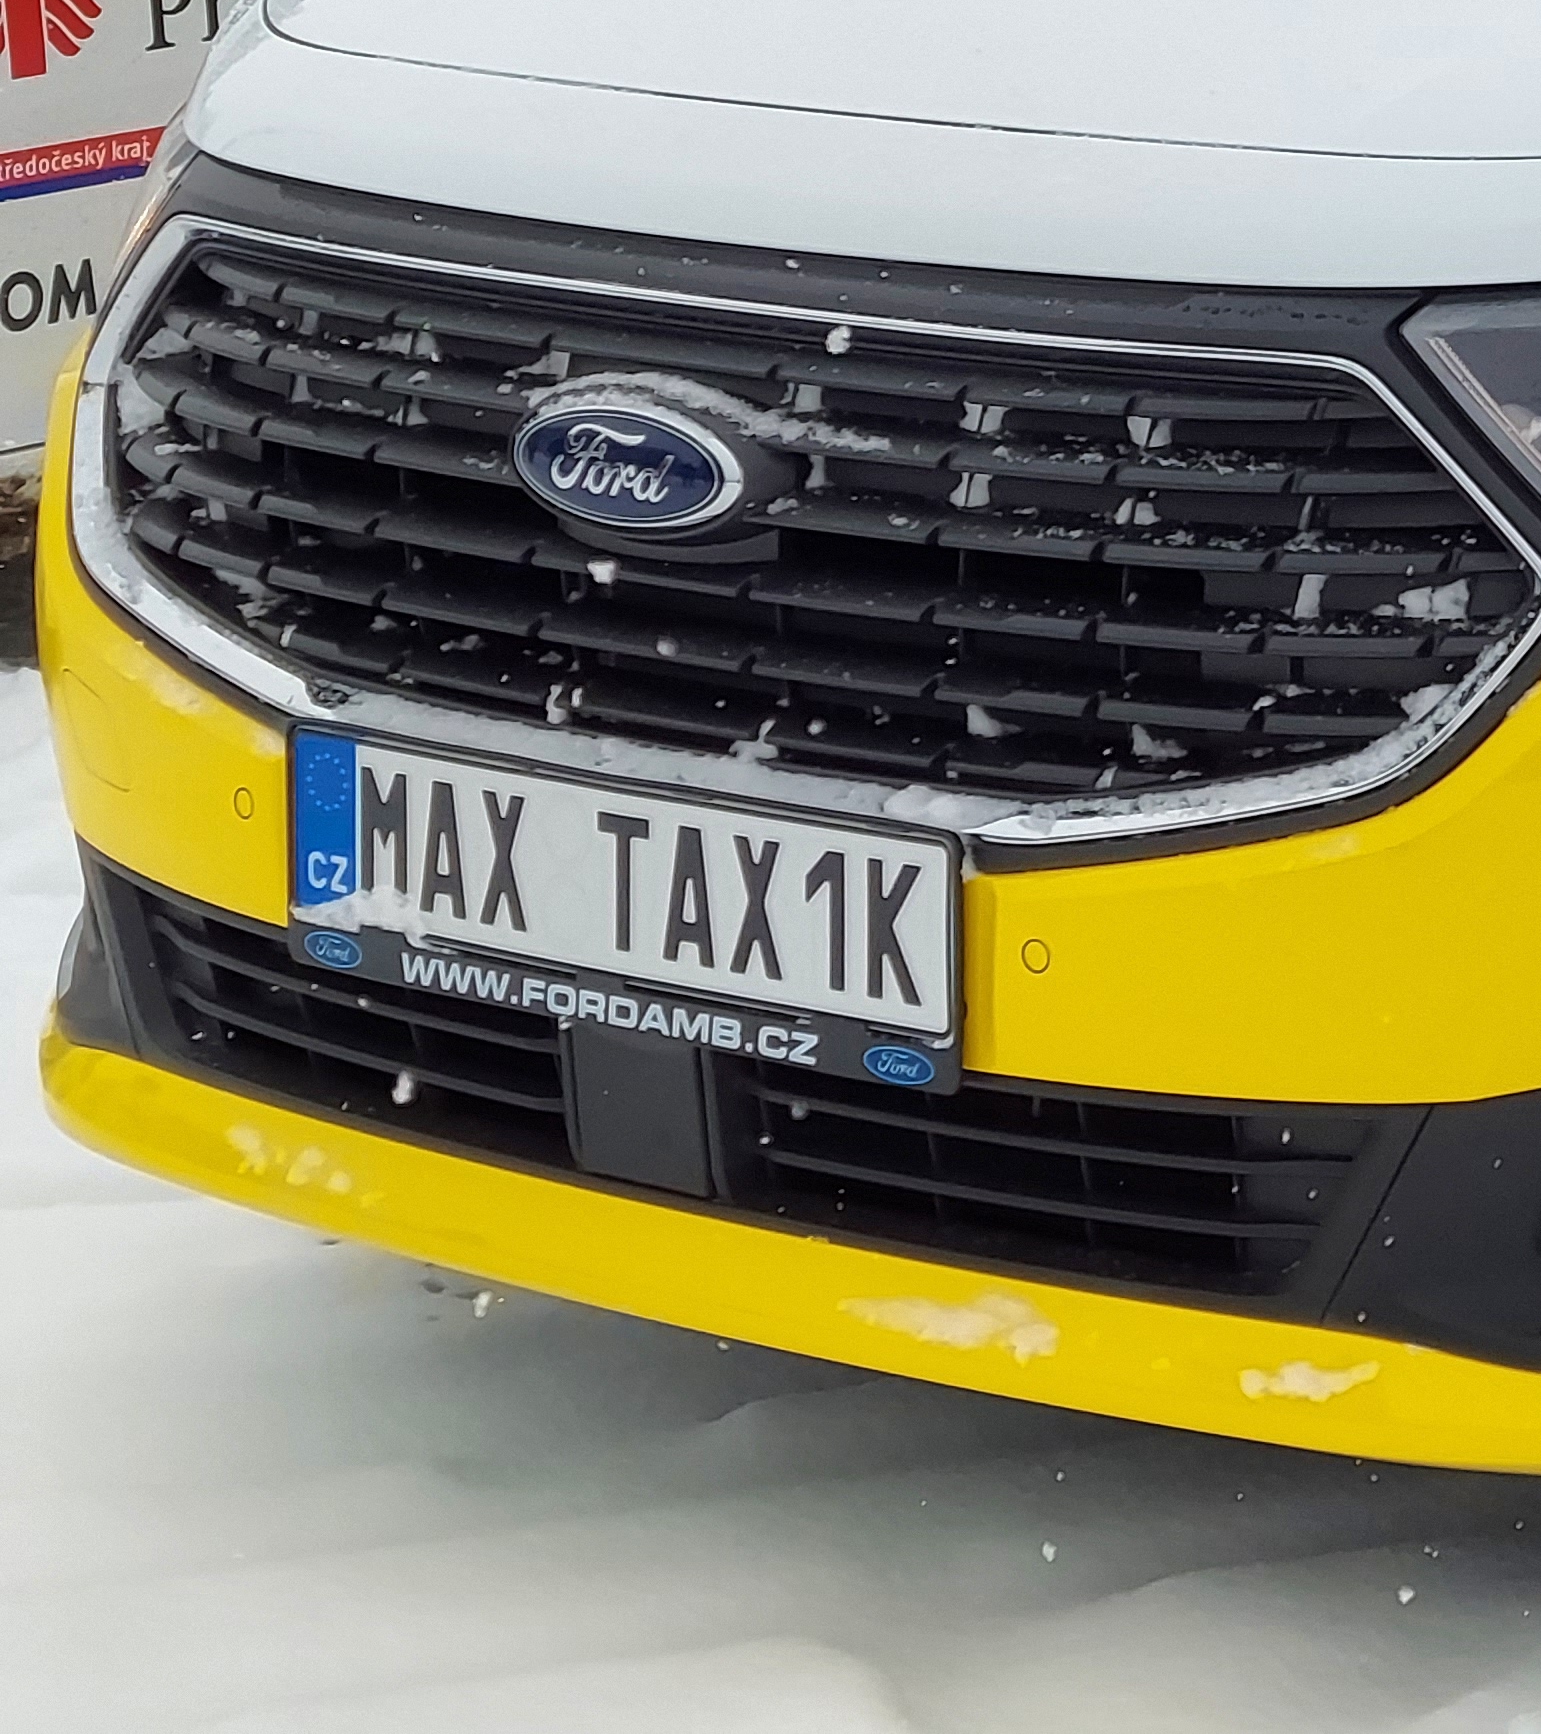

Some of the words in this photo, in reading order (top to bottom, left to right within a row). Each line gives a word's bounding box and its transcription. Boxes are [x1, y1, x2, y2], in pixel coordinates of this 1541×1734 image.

[0, 142, 107, 183] ředočeský
[550, 422, 676, 504] Ford
[307, 850, 350, 895] CZ
[359, 765, 528, 933] MAX
[597, 808, 923, 1008] TAX1K
[400, 951, 822, 1066] WWW.FORDAMB.CZ
[877, 1050, 921, 1078] Ford
